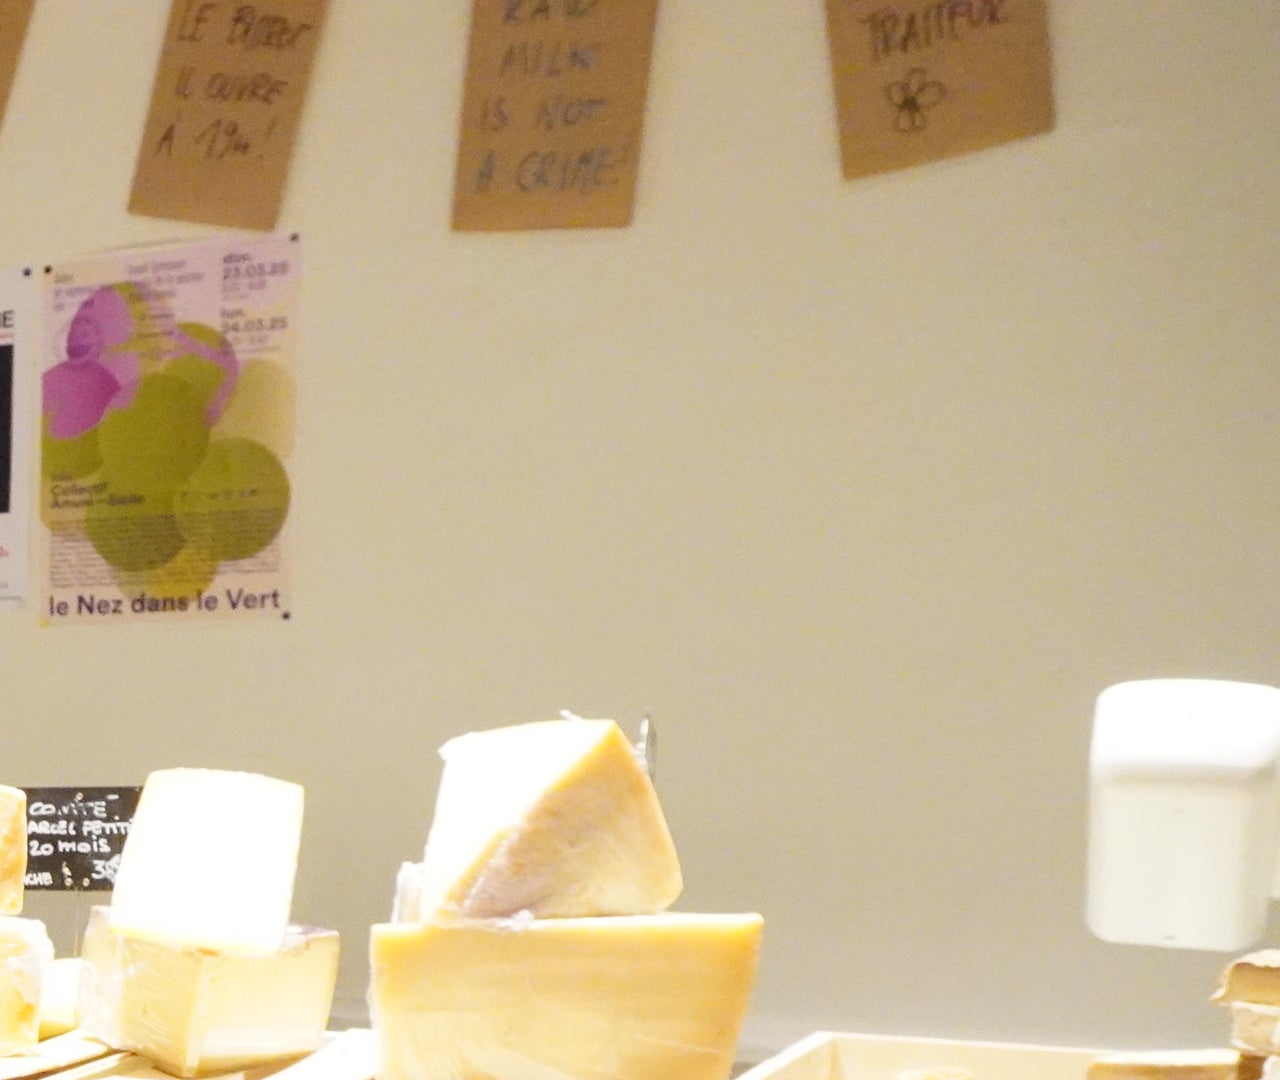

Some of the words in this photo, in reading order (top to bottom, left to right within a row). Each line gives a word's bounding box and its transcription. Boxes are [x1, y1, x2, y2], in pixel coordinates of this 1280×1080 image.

[177, 4, 217, 41] LE
[500, 42, 602, 77] MILK
[49, 595, 69, 616] le
[77, 594, 123, 615] Nez
[131, 592, 189, 614] dans
[198, 589, 219, 610] le
[227, 588, 280, 610] Vert
[28, 820, 76, 835] ARCEL
[29, 840, 54, 856] 20
[58, 835, 111, 853] mois
